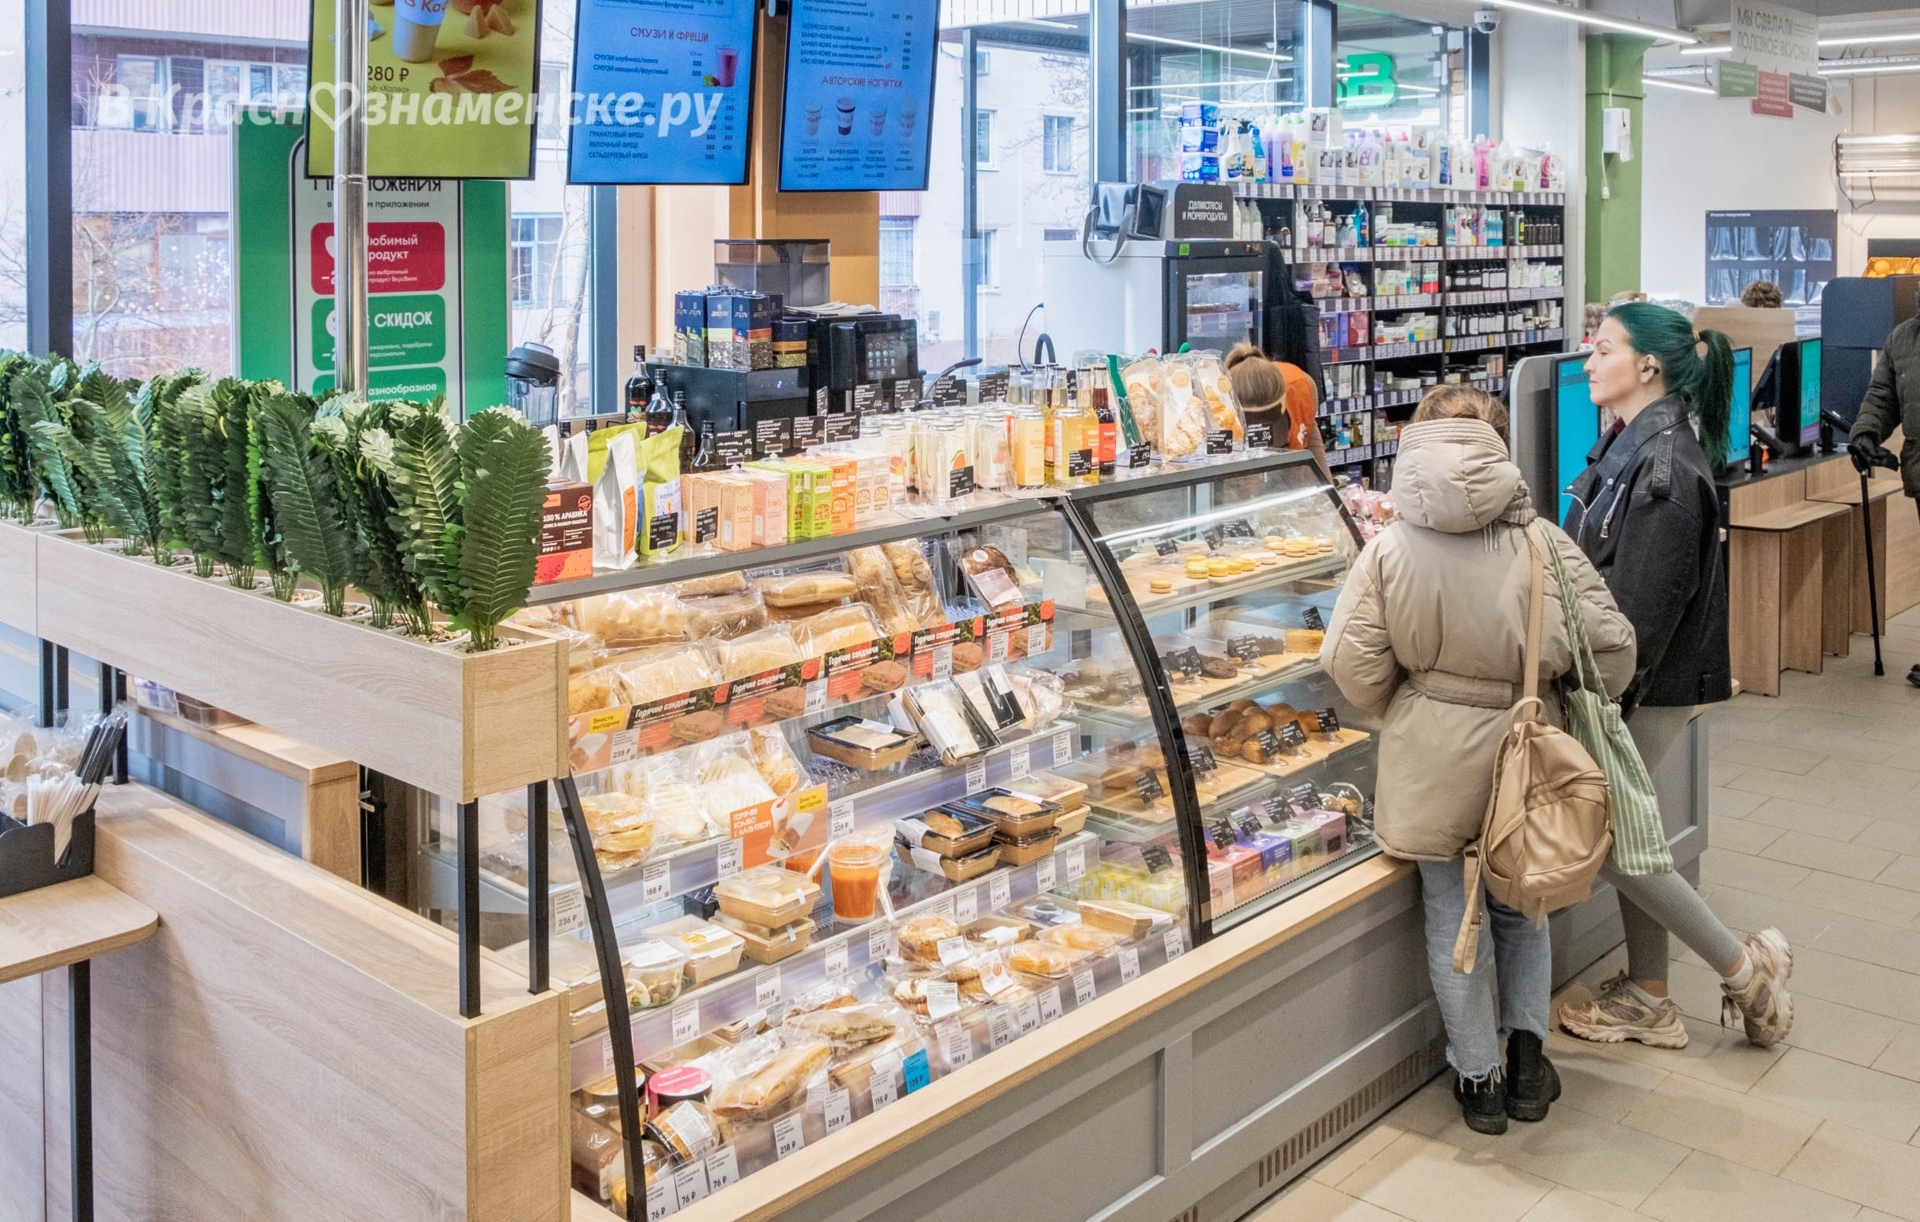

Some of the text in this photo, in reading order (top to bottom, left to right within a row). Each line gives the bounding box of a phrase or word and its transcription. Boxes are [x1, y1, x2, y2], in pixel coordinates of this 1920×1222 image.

[630, 27, 666, 40] СМУЗИ
[375, 200, 430, 210] приложении
[367, 234, 419, 246] юбимый
[368, 251, 410, 263] родукт
[373, 311, 433, 330] СКИДОК
[368, 383, 438, 396] азнообразное
[561, 510, 587, 520] АРАБИКА
[732, 680, 757, 694] Горячие
[634, 696, 698, 719] Горячие сэндвичи
[733, 817, 757, 829] КОМБО
[738, 820, 772, 836] НАПИТКОМ
[646, 887, 657, 897] 188
[558, 916, 571, 926] 236
[874, 1095, 884, 1105] 115
[828, 1116, 840, 1128] 258
[780, 1143, 791, 1155] 218
[712, 1180, 722, 1189] 76
[681, 1195, 691, 1205] 76
[650, 1211, 660, 1221] 76
